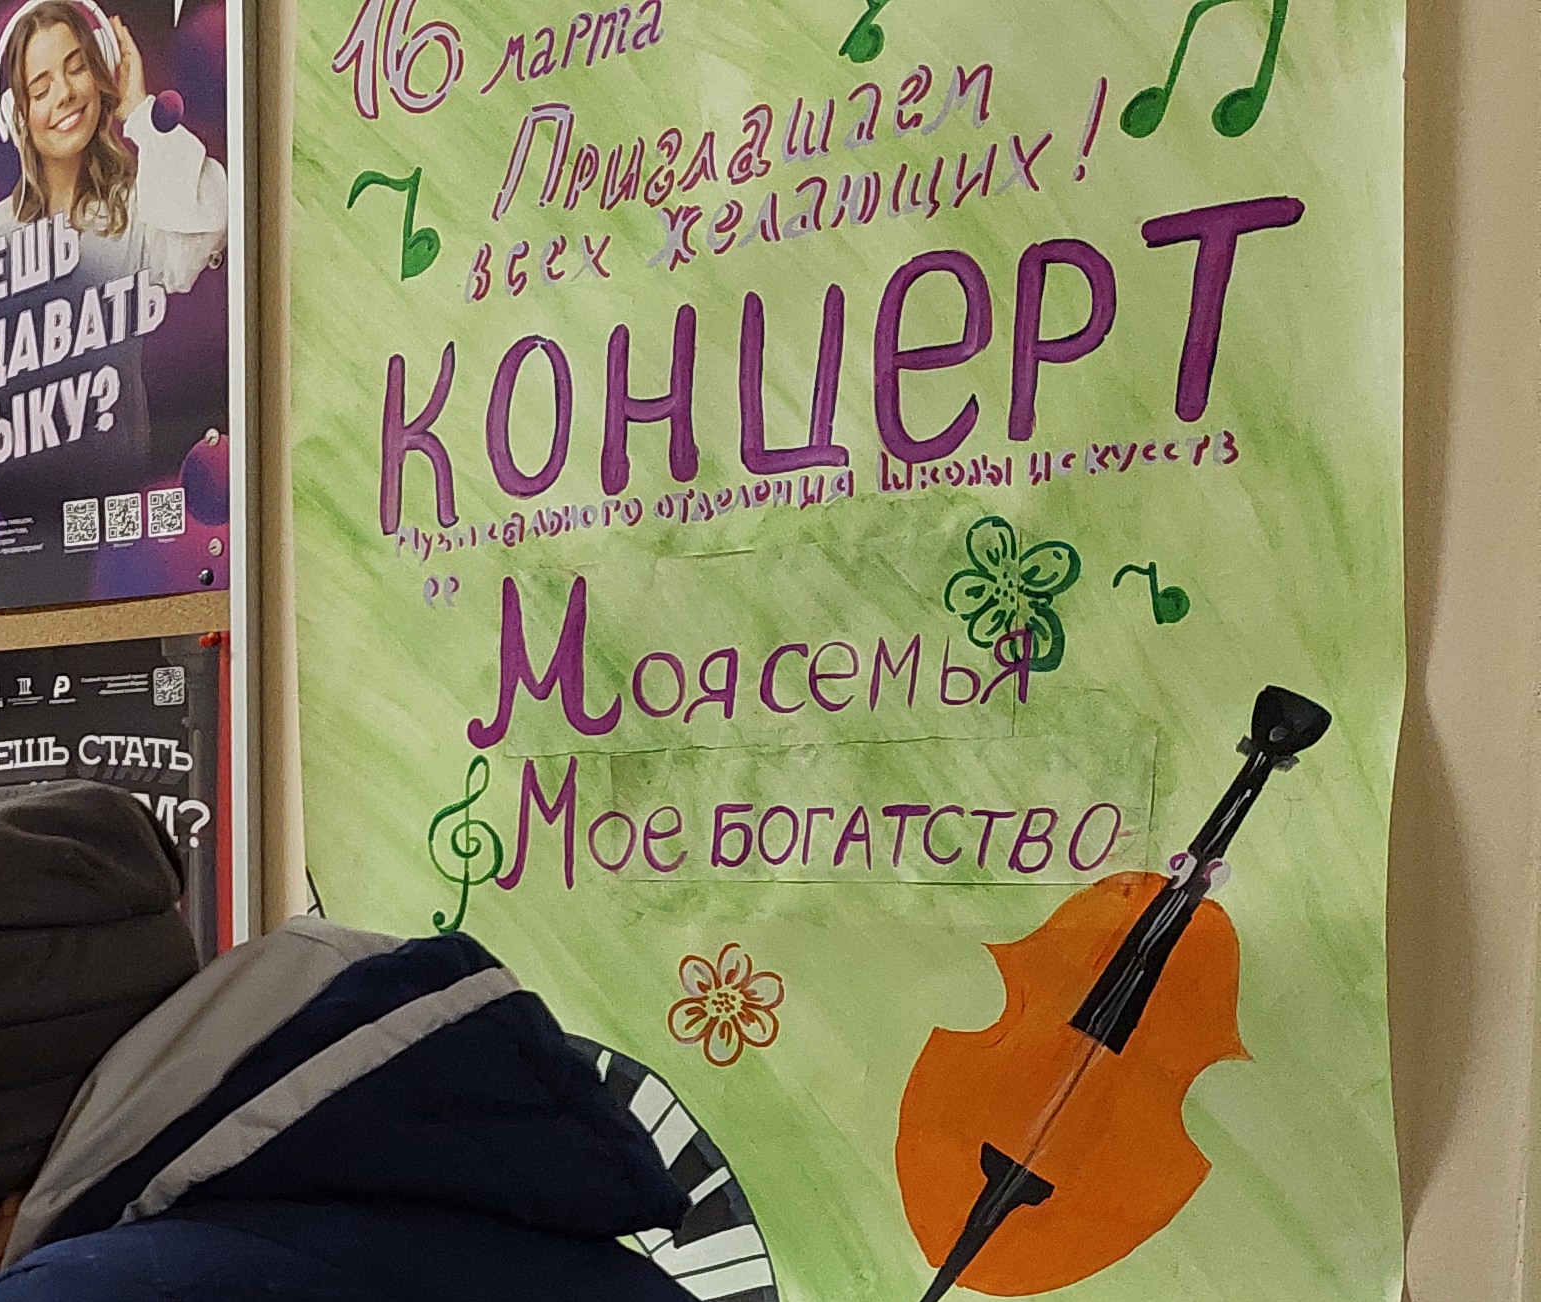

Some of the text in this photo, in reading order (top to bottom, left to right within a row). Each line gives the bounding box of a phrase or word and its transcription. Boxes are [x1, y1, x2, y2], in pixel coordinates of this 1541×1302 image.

[332, 0, 664, 120] 16 марта
[491, 64, 994, 221] Приглашаем
[77, 734, 193, 773] СТАТЬ
